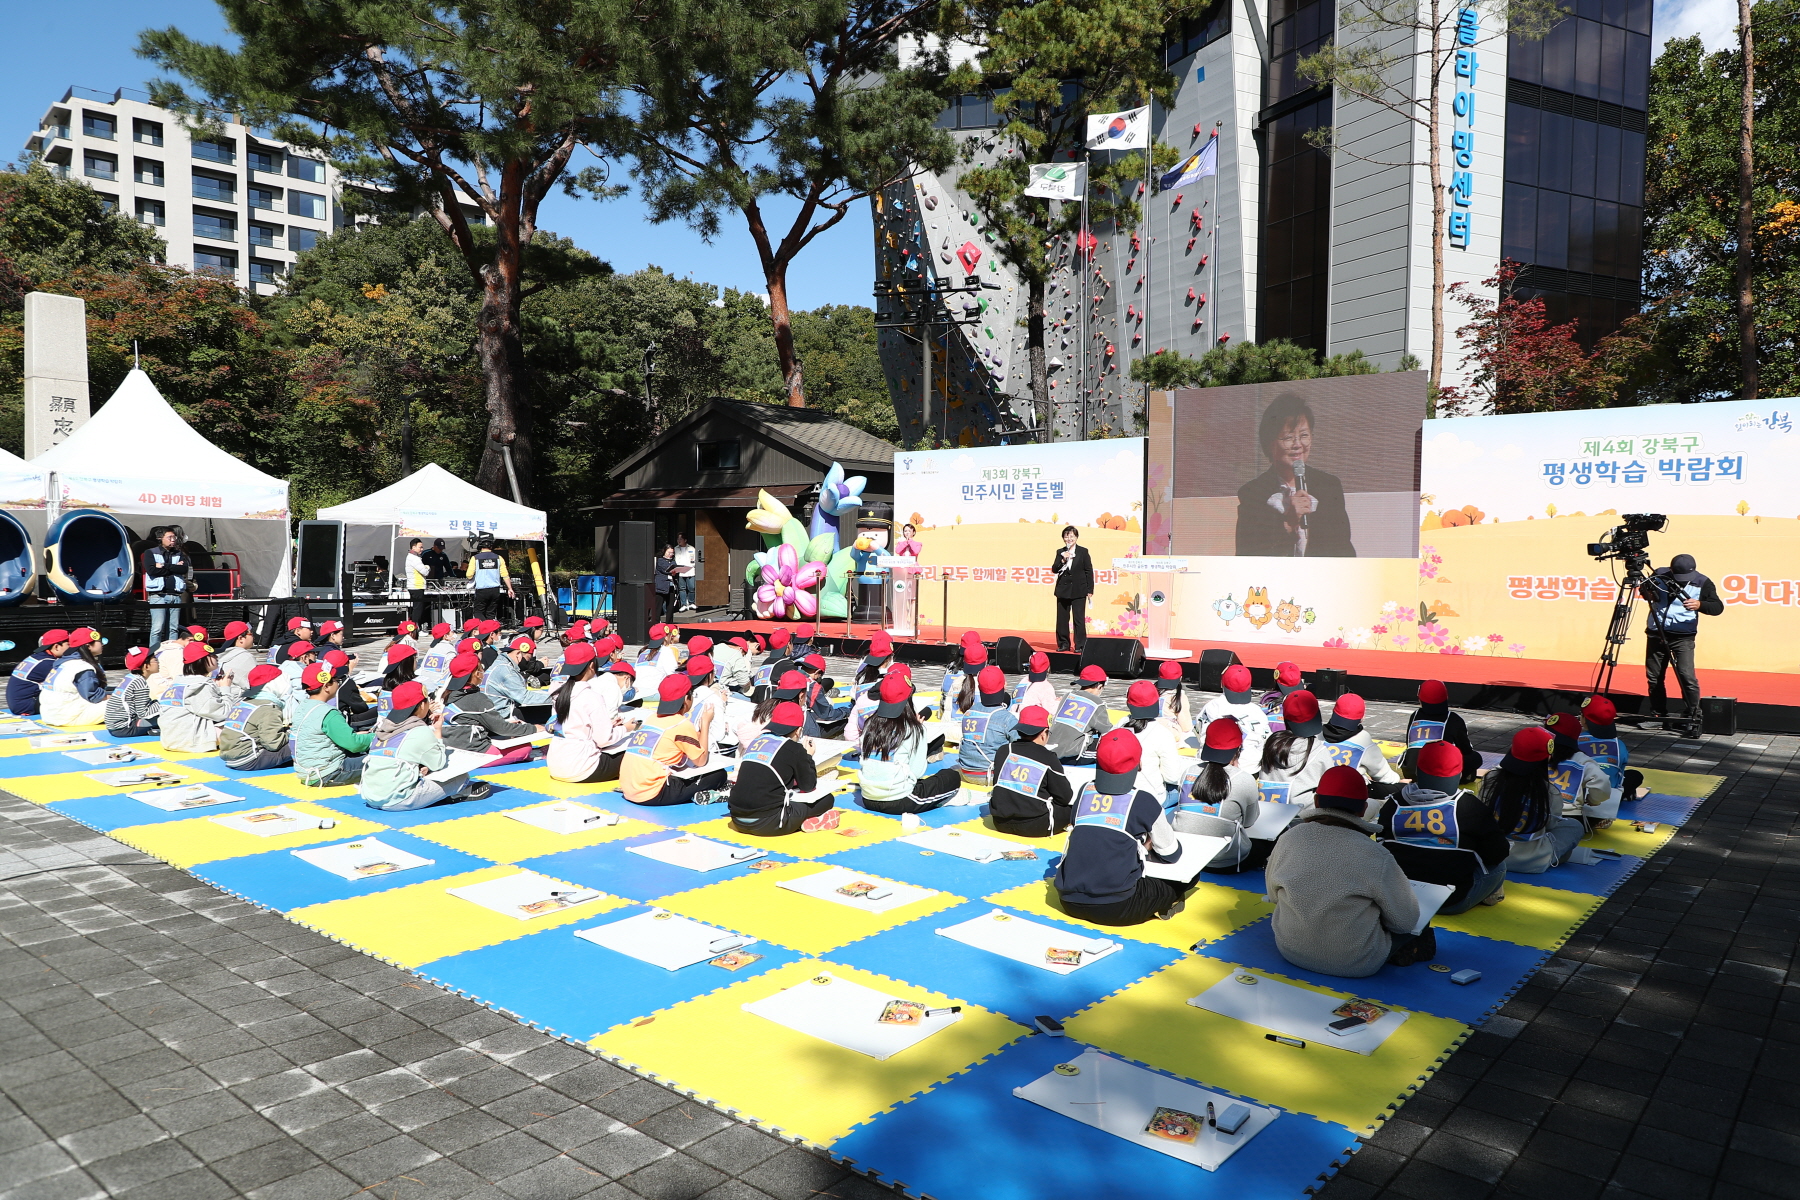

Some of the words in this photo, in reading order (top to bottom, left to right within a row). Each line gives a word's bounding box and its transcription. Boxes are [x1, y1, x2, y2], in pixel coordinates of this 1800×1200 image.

[1450, 0, 1480, 247] 클라이밍센터
[1762, 411, 1793, 433] 강북
[1583, 440, 1634, 457] 제4회
[1642, 436, 1699, 455] 강북구
[982, 469, 1008, 481] 제3회
[1012, 467, 1042, 480] 강북구
[1543, 459, 1648, 485] 평생학습
[1658, 456, 1743, 482] 박람회
[962, 483, 1015, 501] 민주시민
[1020, 482, 1064, 500] 골든벨
[138, 493, 157, 504] 4D
[161, 494, 196, 507] 라이딩
[199, 495, 222, 508] 체험
[942, 566, 968, 581] 모두
[972, 568, 1007, 582] 함께할
[1508, 576, 1616, 601] 평생학습
[425, 656, 439, 668] 26
[1063, 701, 1087, 720] 21
[964, 718, 979, 732] 33
[1416, 727, 1431, 739] 11
[632, 732, 649, 746] 56
[750, 739, 771, 752] 57
[1589, 743, 1609, 755] 12
[1010, 766, 1030, 782] 46
[1089, 793, 1113, 813] 59
[1403, 808, 1447, 835] 48
